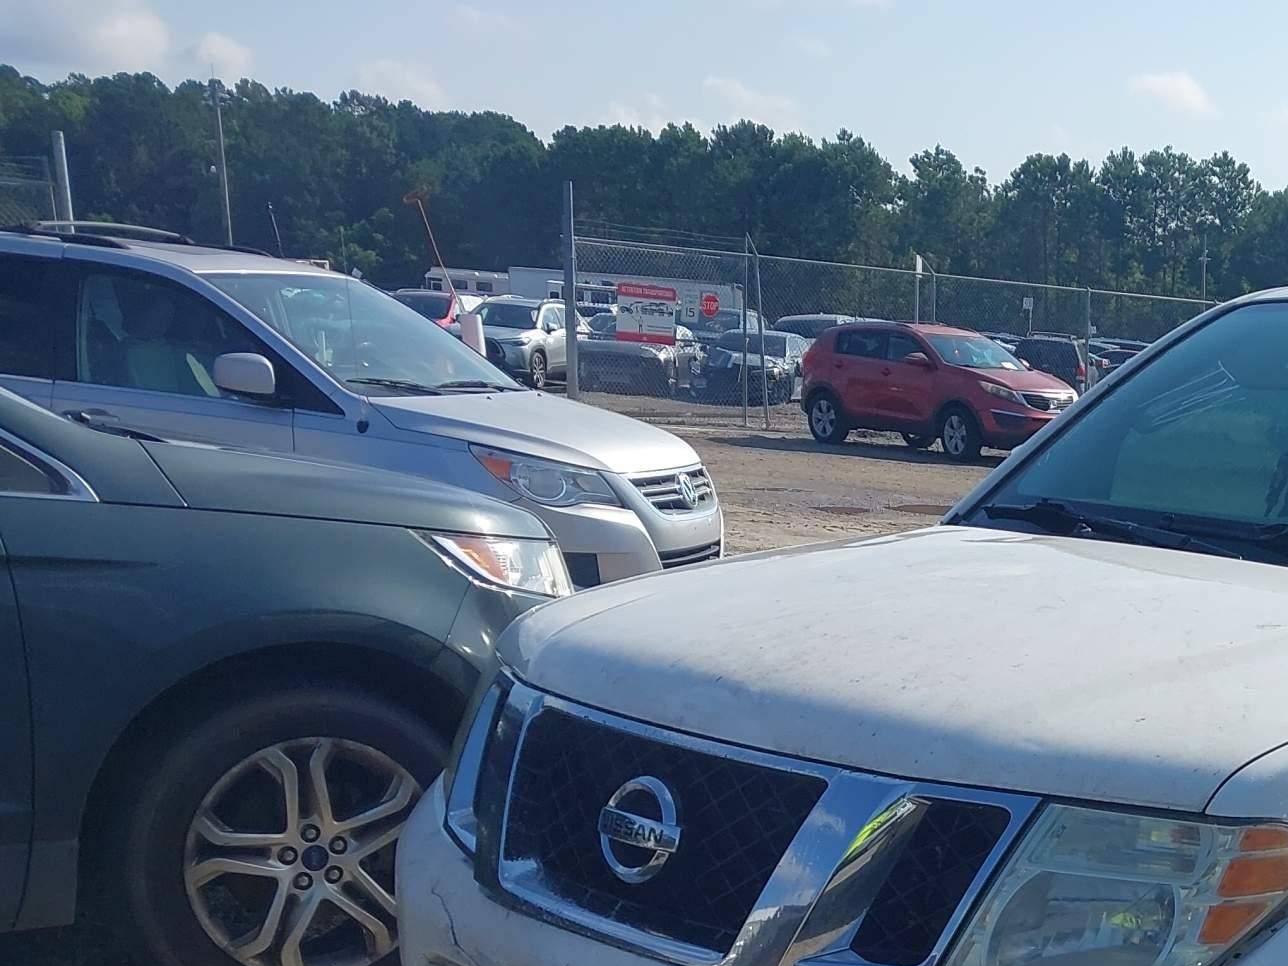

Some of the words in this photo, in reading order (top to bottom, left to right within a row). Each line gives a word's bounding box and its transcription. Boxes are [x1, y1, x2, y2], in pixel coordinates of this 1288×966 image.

[703, 300, 719, 310] STOP
[685, 307, 695, 317] 15
[601, 810, 664, 845] NISSAN
